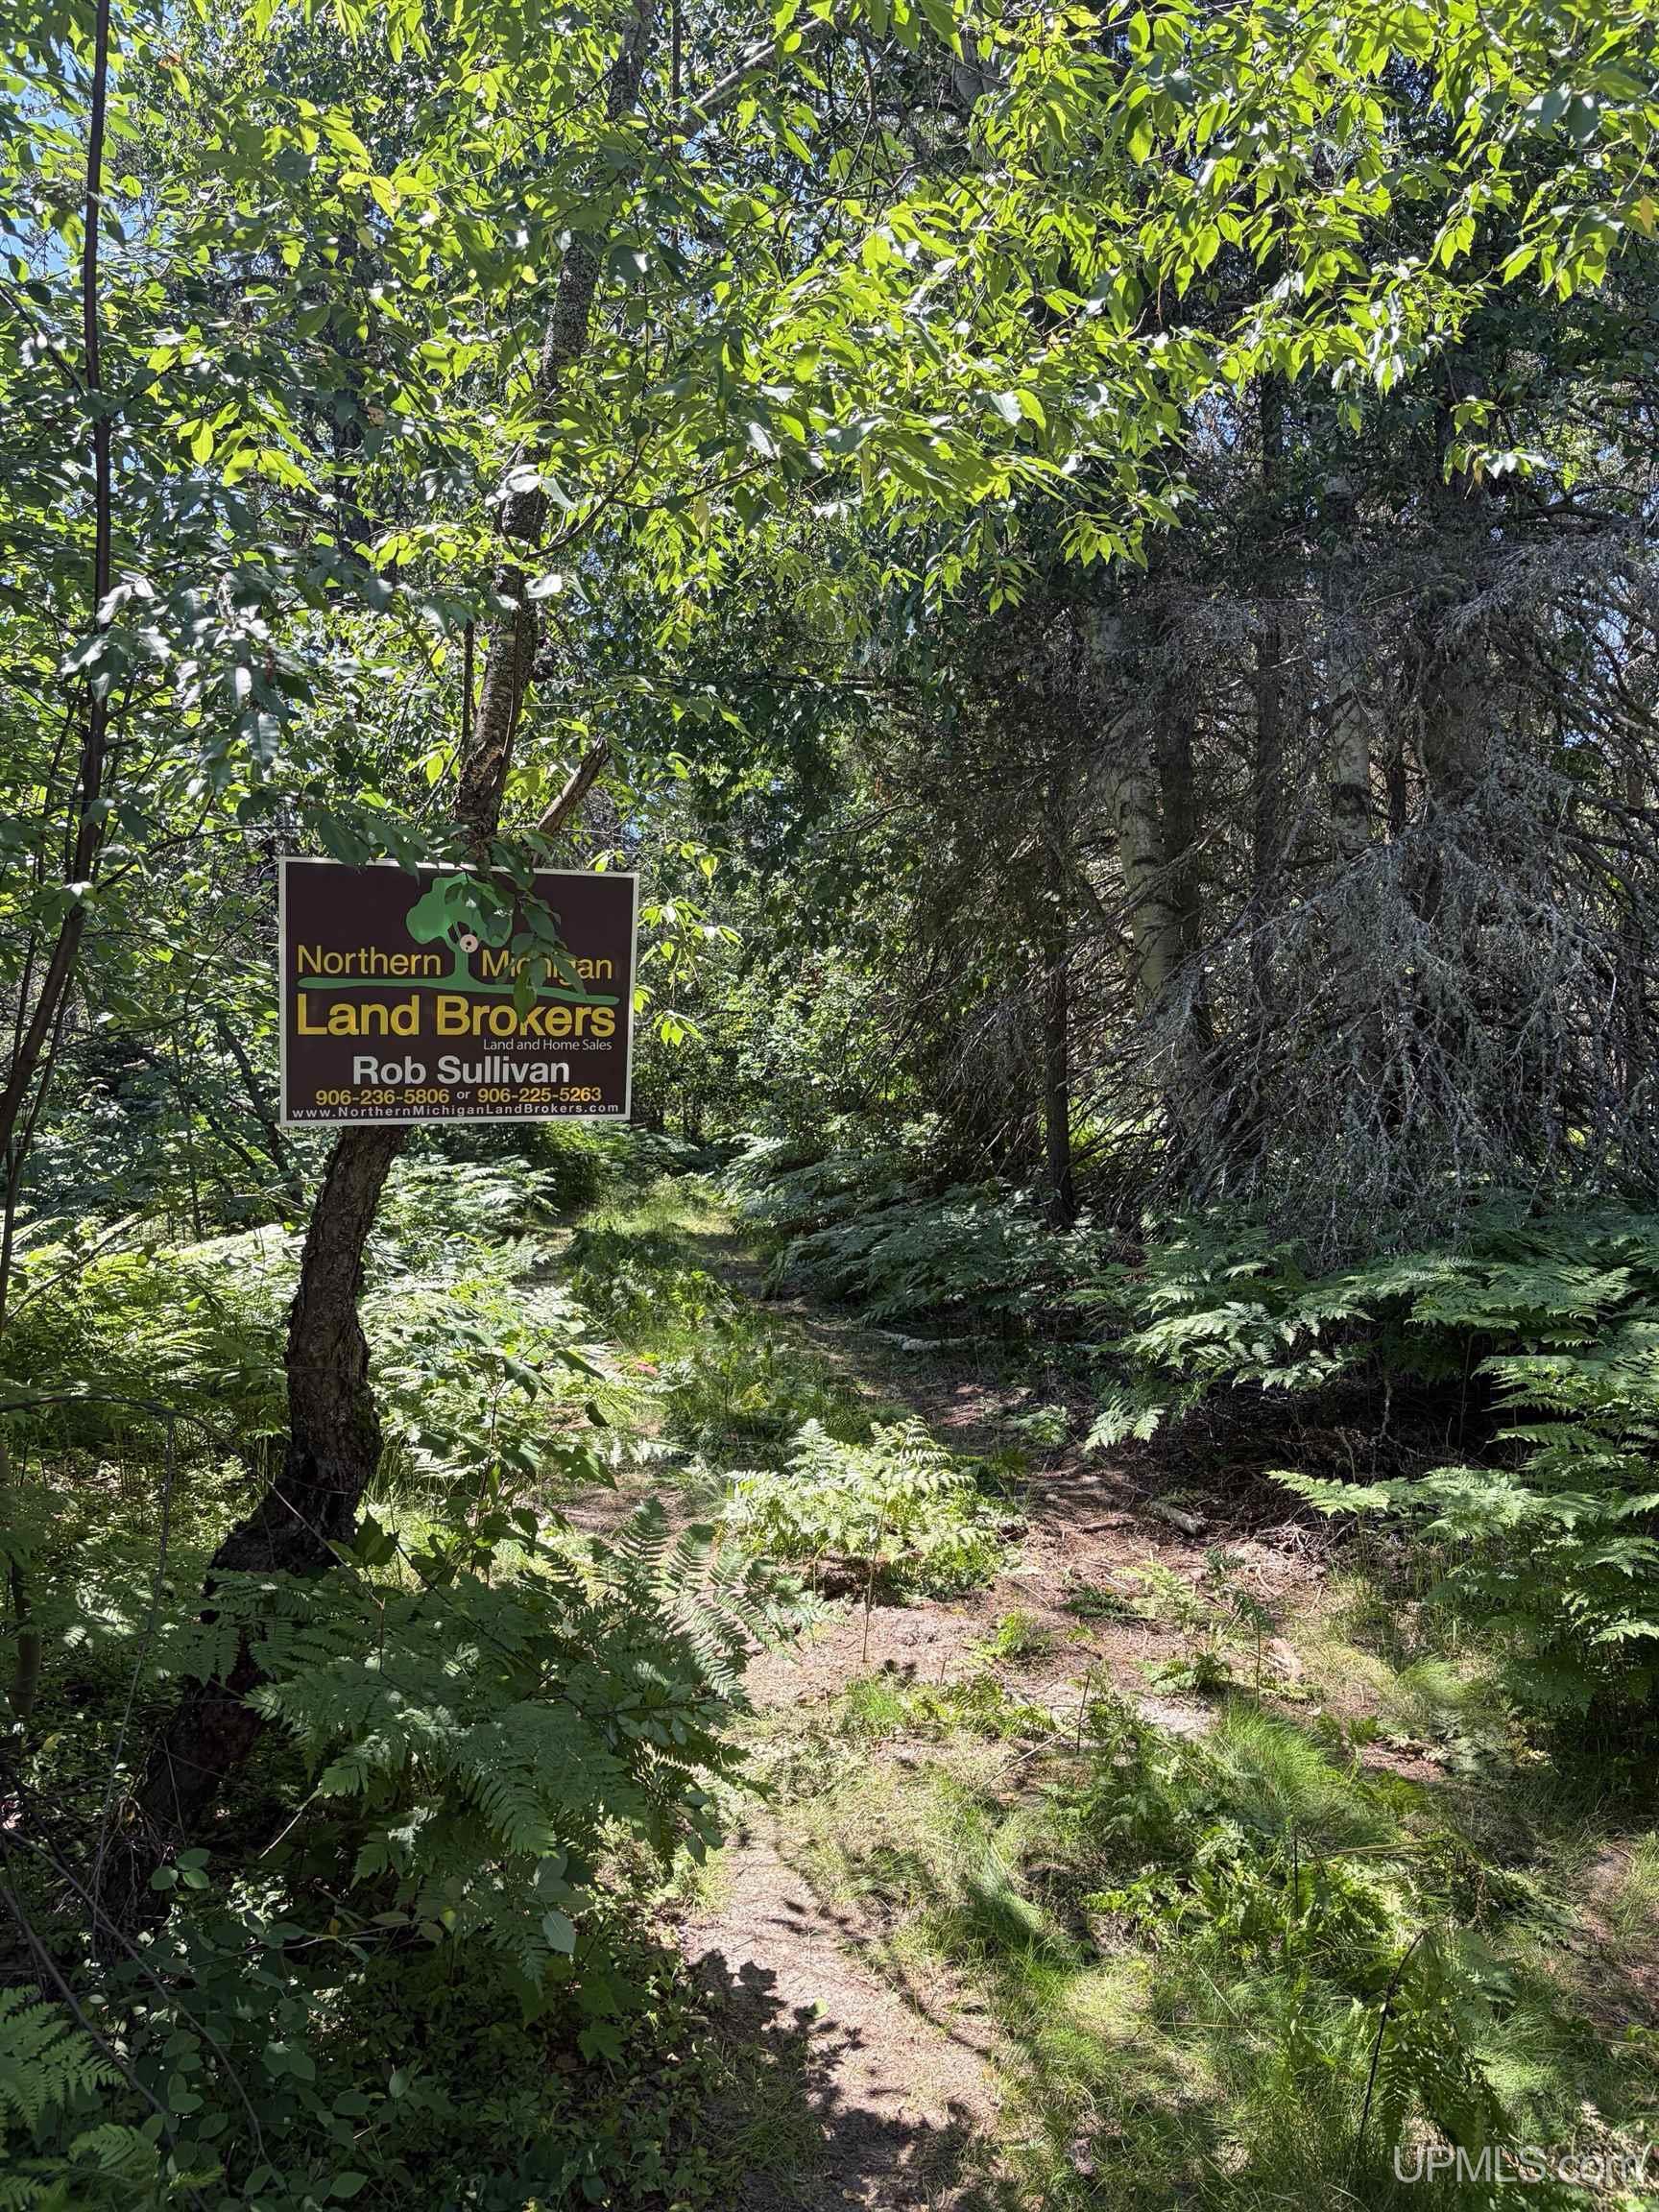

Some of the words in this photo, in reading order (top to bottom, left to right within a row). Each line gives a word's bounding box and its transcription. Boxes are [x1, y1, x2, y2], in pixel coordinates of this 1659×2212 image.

[297, 945, 442, 975] Northern
[297, 994, 420, 1036] Land
[436, 995, 615, 1037] Brokers
[483, 1038, 514, 1050] Land
[517, 1039, 541, 1050] and
[543, 1039, 580, 1051] Home
[582, 1039, 613, 1051] Sales
[353, 1055, 426, 1085] Rob
[437, 1055, 569, 1084] Sullivan
[315, 1089, 450, 1106] 906-236-5806
[456, 1090, 471, 1100] or
[477, 1087, 602, 1103] 906-225-5263
[292, 1103, 619, 1119] www.NorthernMichiganLandBrokers.com
